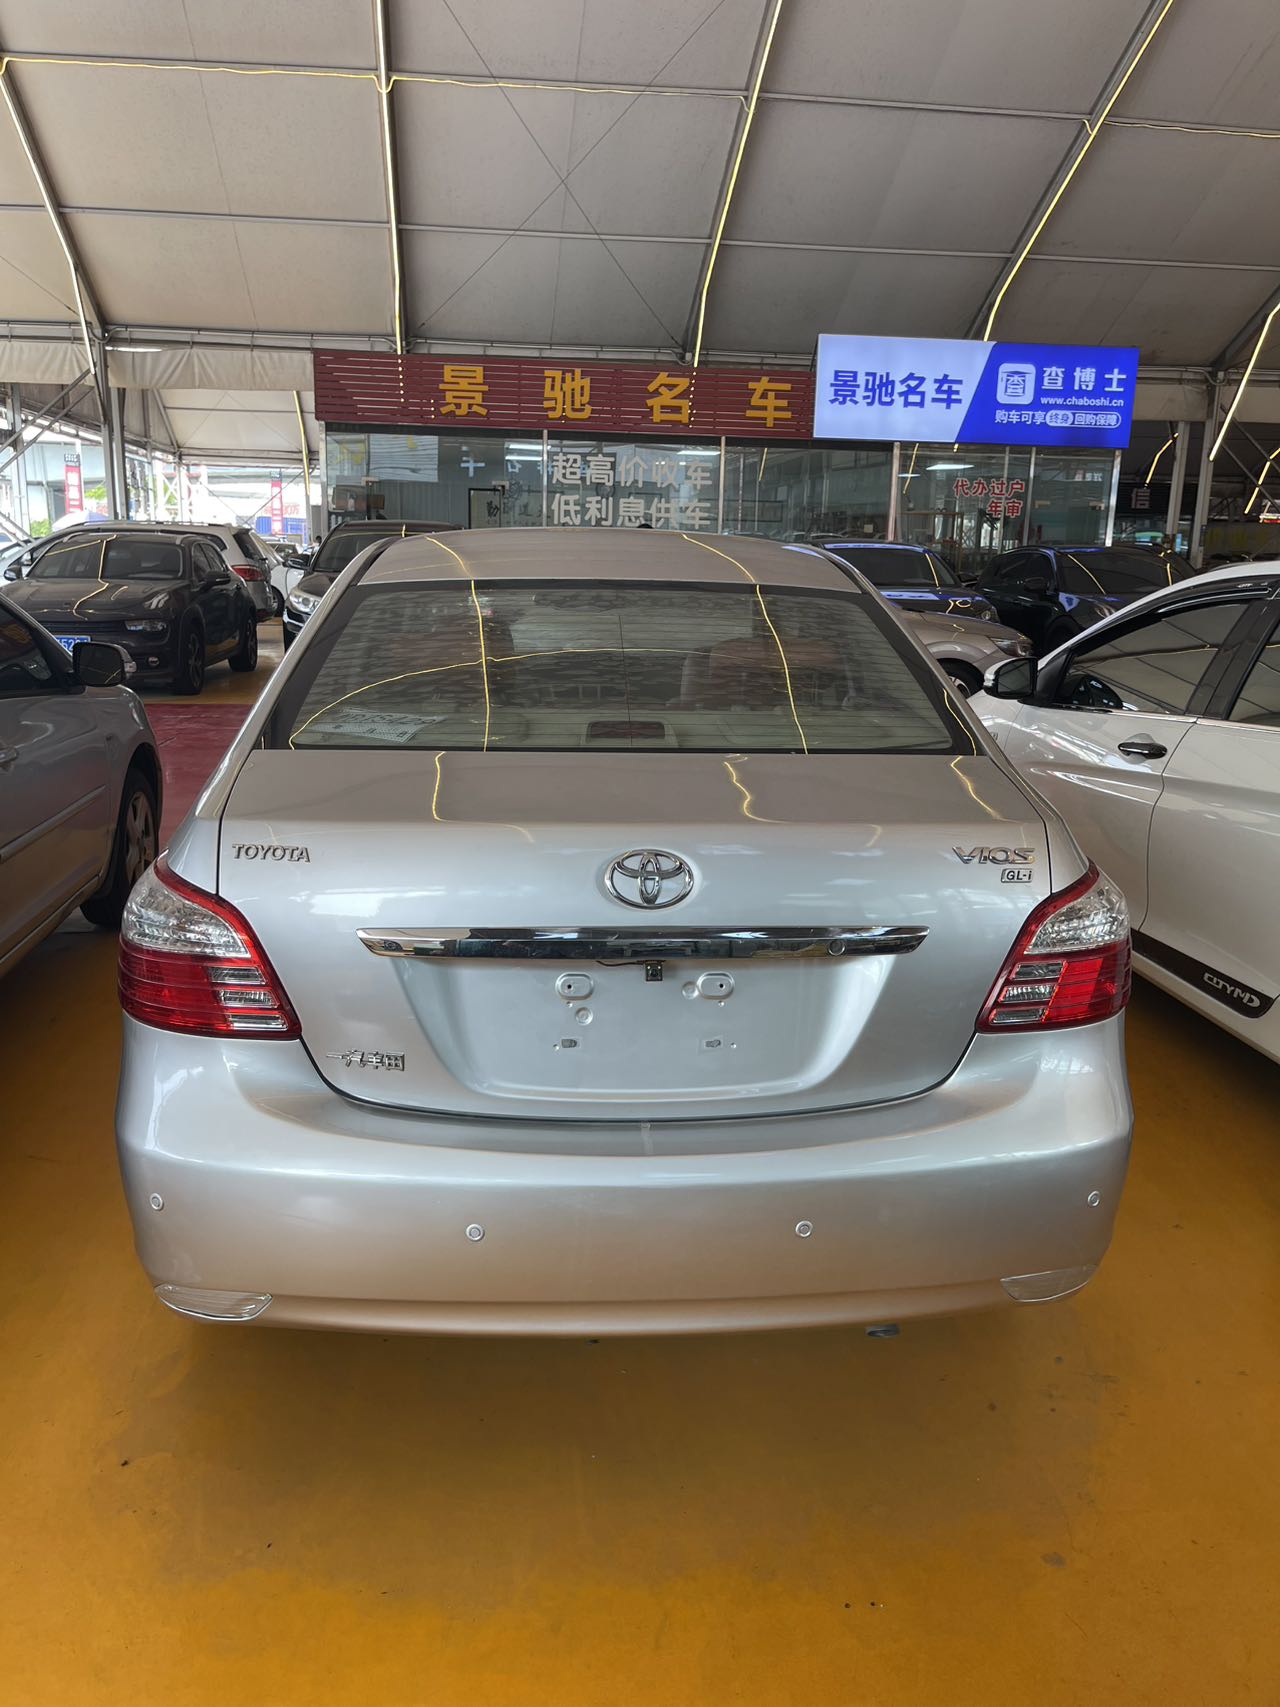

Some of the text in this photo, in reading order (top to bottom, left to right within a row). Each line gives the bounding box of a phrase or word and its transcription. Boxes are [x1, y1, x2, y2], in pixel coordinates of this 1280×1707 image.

[828, 369, 963, 409] 景驰名车
[1041, 366, 1127, 391] 查博士
[438, 364, 792, 428] 景驰名车
[1040, 396, 1124, 407] www.chaboshi.cn
[551, 452, 713, 490] 超高价收车
[954, 477, 1025, 497] 代办过户
[551, 492, 712, 530] 低利息供车
[986, 500, 1023, 518] 年审
[232, 843, 311, 863] TOYOTA
[952, 846, 1036, 865] VIOS
[326, 1050, 405, 1072] 一汽丰田
